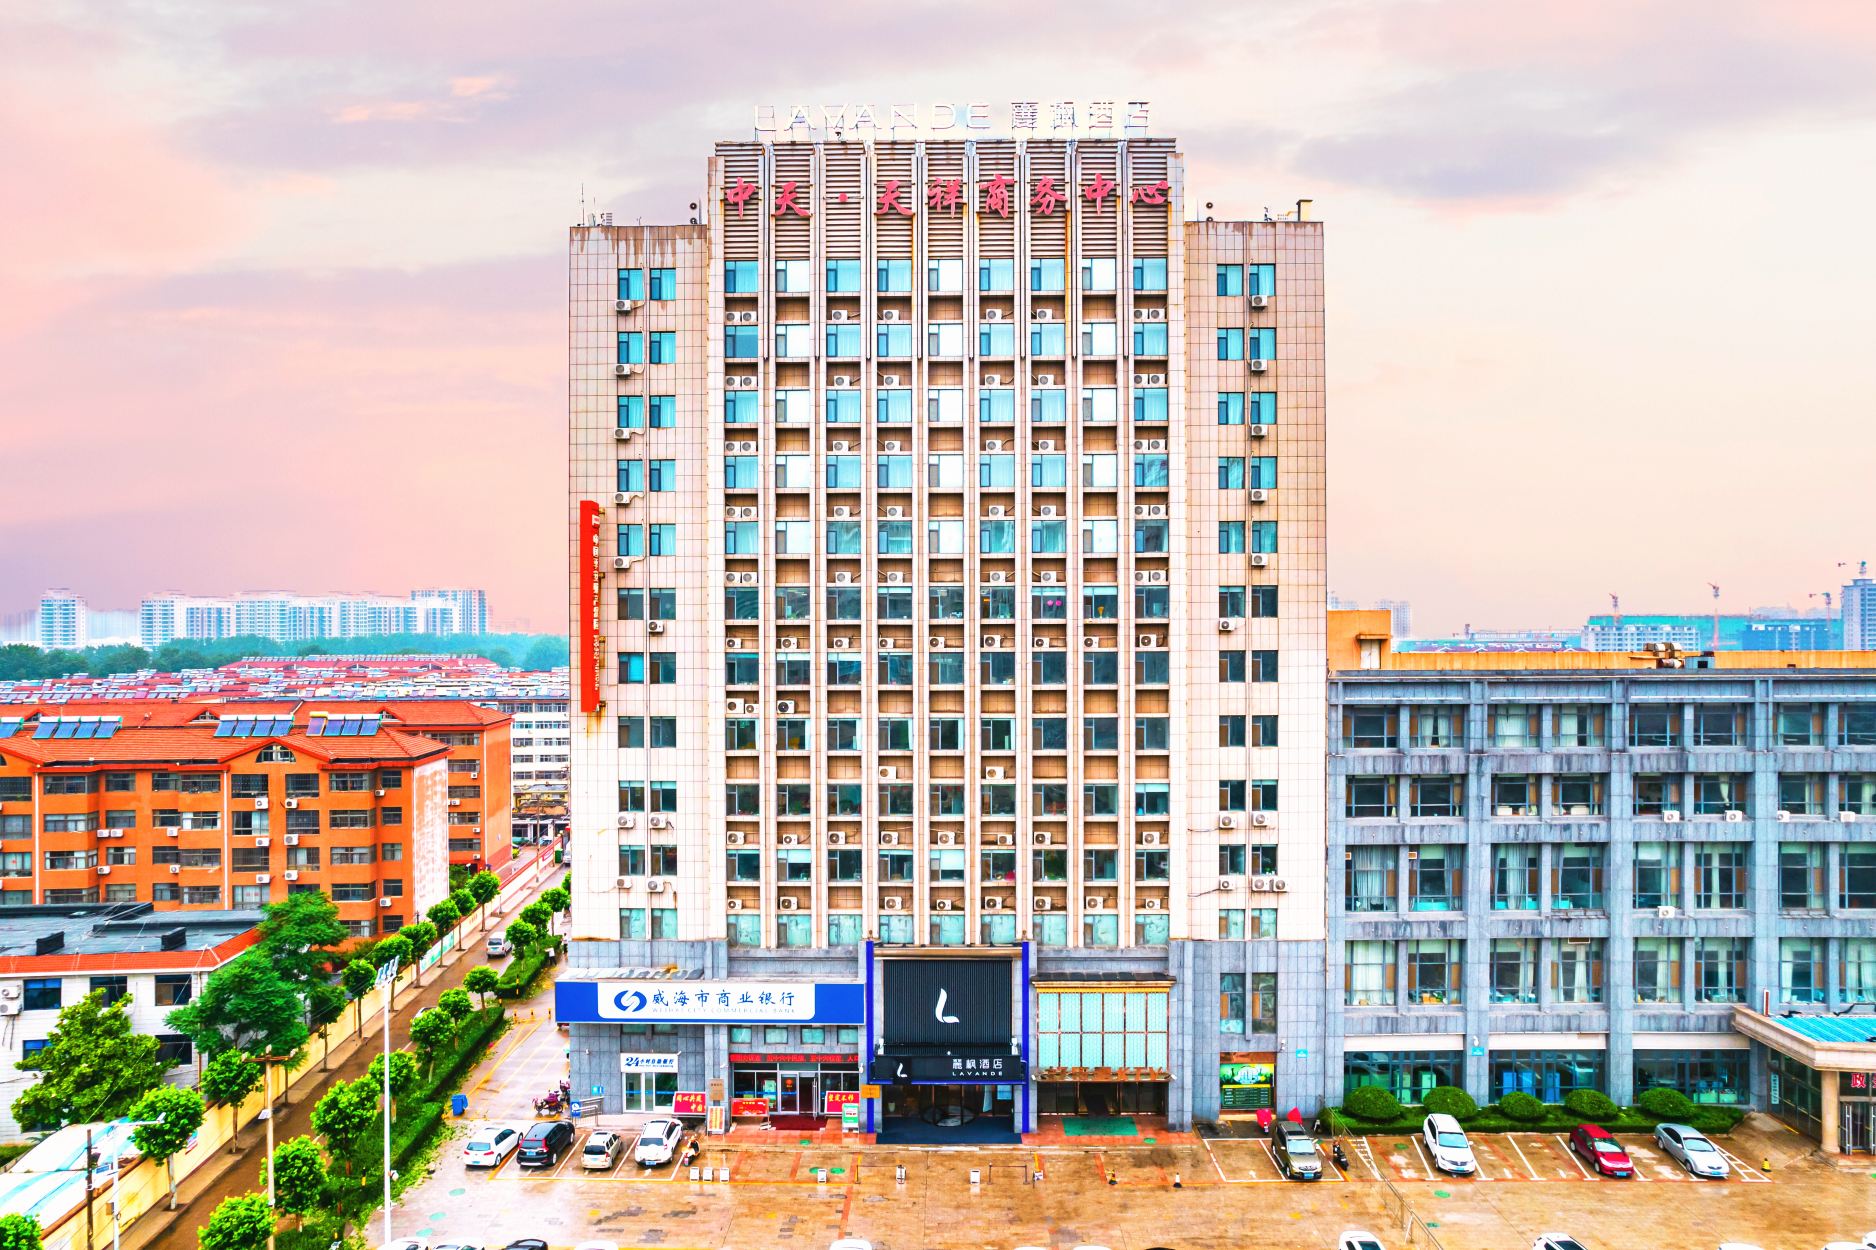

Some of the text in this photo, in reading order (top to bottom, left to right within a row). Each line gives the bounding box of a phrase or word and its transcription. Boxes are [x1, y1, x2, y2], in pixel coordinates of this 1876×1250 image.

[754, 103, 991, 131] LAVANDE
[652, 988, 795, 1007] 威海市商业银行
